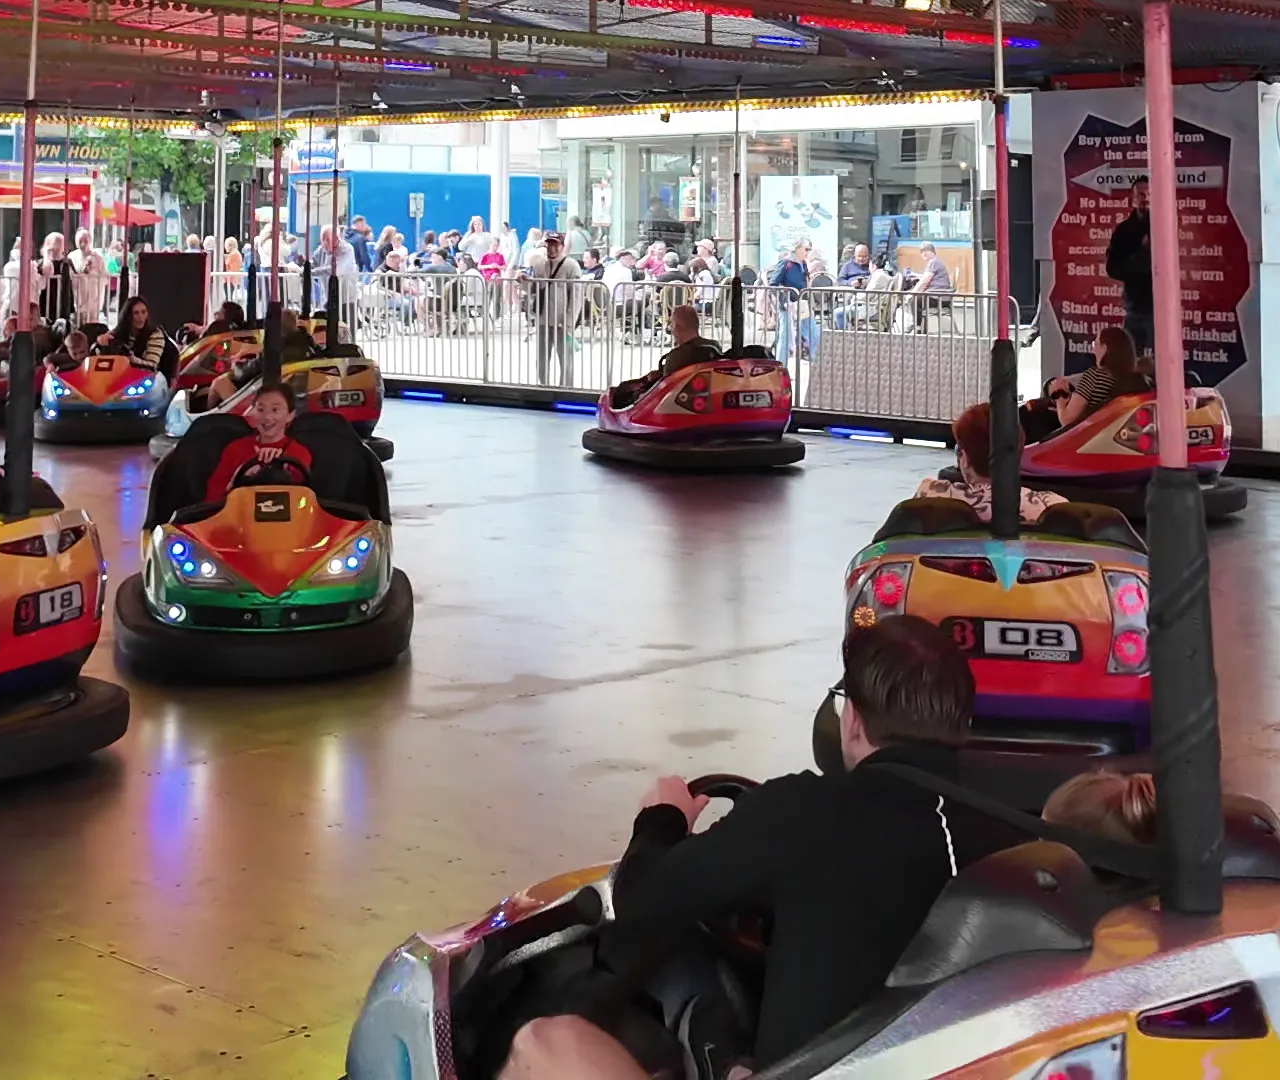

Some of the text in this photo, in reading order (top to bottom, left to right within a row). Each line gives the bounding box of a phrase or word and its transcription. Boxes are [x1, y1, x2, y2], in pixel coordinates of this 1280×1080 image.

[1078, 135, 1101, 147] Buy
[1105, 135, 1132, 147] your
[1104, 149, 1149, 160] the cas
[1096, 175, 1122, 184] one
[1177, 171, 1206, 183] und
[1080, 198, 1096, 208] No
[1099, 197, 1128, 208] head
[1062, 214, 1087, 225] Only
[1100, 215, 1111, 223] or
[1207, 215, 1228, 224] car
[1191, 245, 1223, 256] adult
[1067, 263, 1095, 276] Seat
[1190, 271, 1224, 281] worn
[1062, 301, 1098, 315] Stand
[1102, 303, 1127, 316] clea
[1206, 311, 1236, 322] cars
[1061, 320, 1089, 334] Wait
[1182, 327, 1237, 343] finished
[1193, 349, 1228, 363] track
[338, 393, 360, 402] 20
[1188, 429, 1210, 440] 04
[49, 590, 73, 613] 18
[1000, 627, 1064, 647] 08
